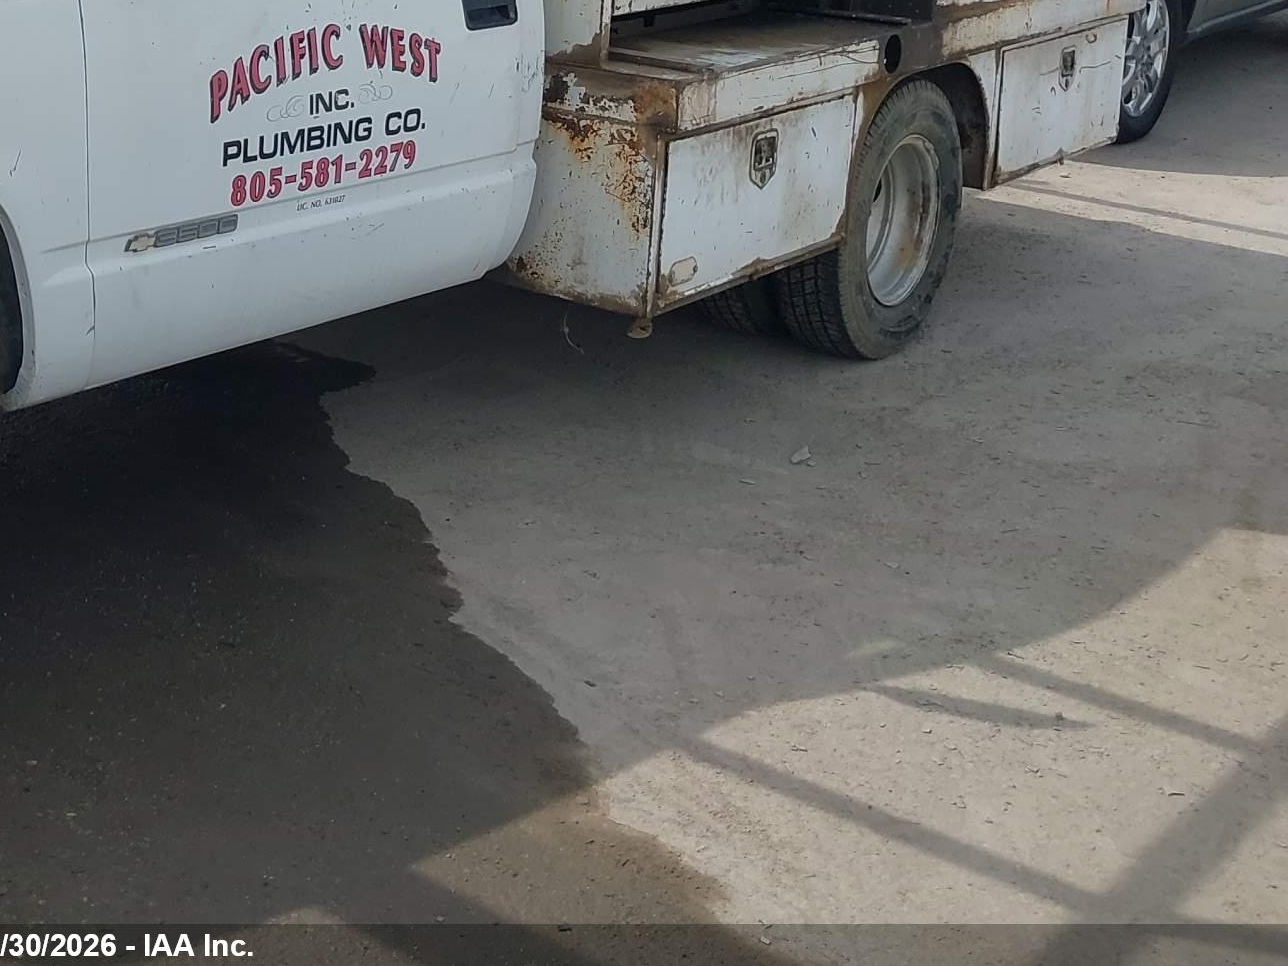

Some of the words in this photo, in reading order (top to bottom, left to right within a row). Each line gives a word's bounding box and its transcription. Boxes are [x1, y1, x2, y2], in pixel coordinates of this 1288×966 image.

[210, 24, 344, 123] PACIFIC
[359, 23, 441, 83] WEST
[310, 88, 355, 115] INC.
[223, 117, 372, 167] PLUMBING
[385, 108, 426, 136] CO.
[230, 140, 417, 207] 805-581-2279
